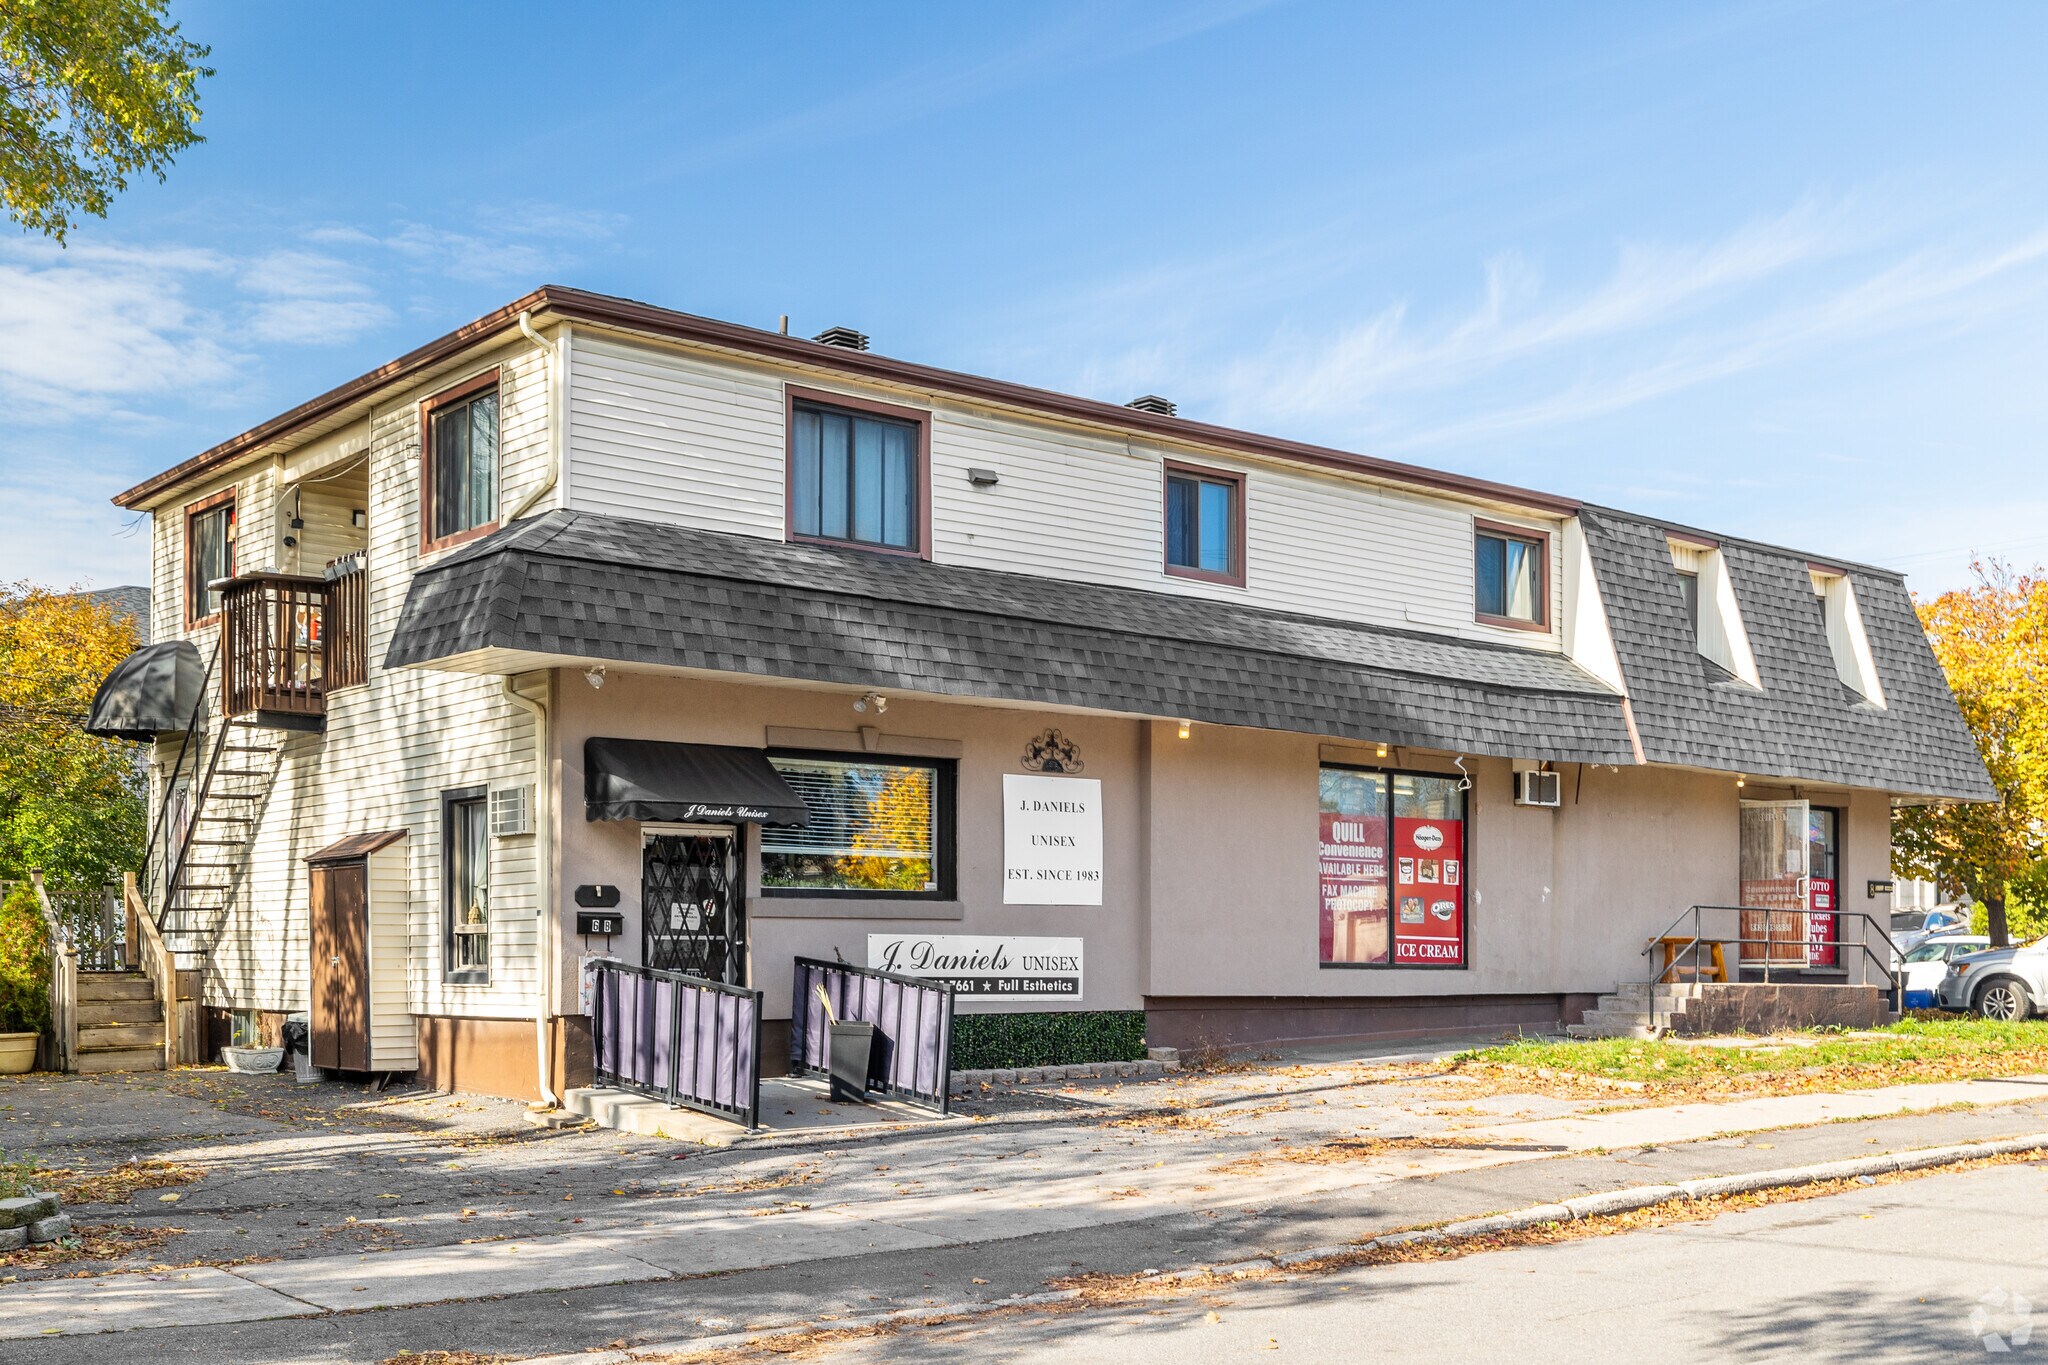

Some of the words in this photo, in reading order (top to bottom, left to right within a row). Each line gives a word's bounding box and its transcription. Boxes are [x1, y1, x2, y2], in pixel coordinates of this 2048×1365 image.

[697, 805, 735, 817] Daniels
[736, 806, 769, 819] Unisex
[1020, 800, 1030, 811] J.
[1033, 801, 1086, 813] DANIELS
[1332, 821, 1366, 843] QUILL
[1031, 835, 1076, 847] UNISEX
[1319, 841, 1384, 859] Convenience
[1008, 868, 1033, 880] EST.
[1036, 869, 1073, 881] SINCE
[1077, 870, 1100, 881] 1983
[1319, 862, 1361, 875] AVAILABLE
[1363, 864, 1384, 877] HERE
[1322, 884, 1338, 897] FAX
[1340, 885, 1378, 898] MACHINE
[1324, 898, 1374, 912] PHOTOCOPY
[910, 940, 1014, 971] Daniels
[1022, 955, 1079, 971] UNISEX
[1396, 943, 1417, 957] ICE
[1418, 944, 1459, 959] CREAM
[998, 979, 1019, 991] Full
[1023, 979, 1073, 992] Esthetics
